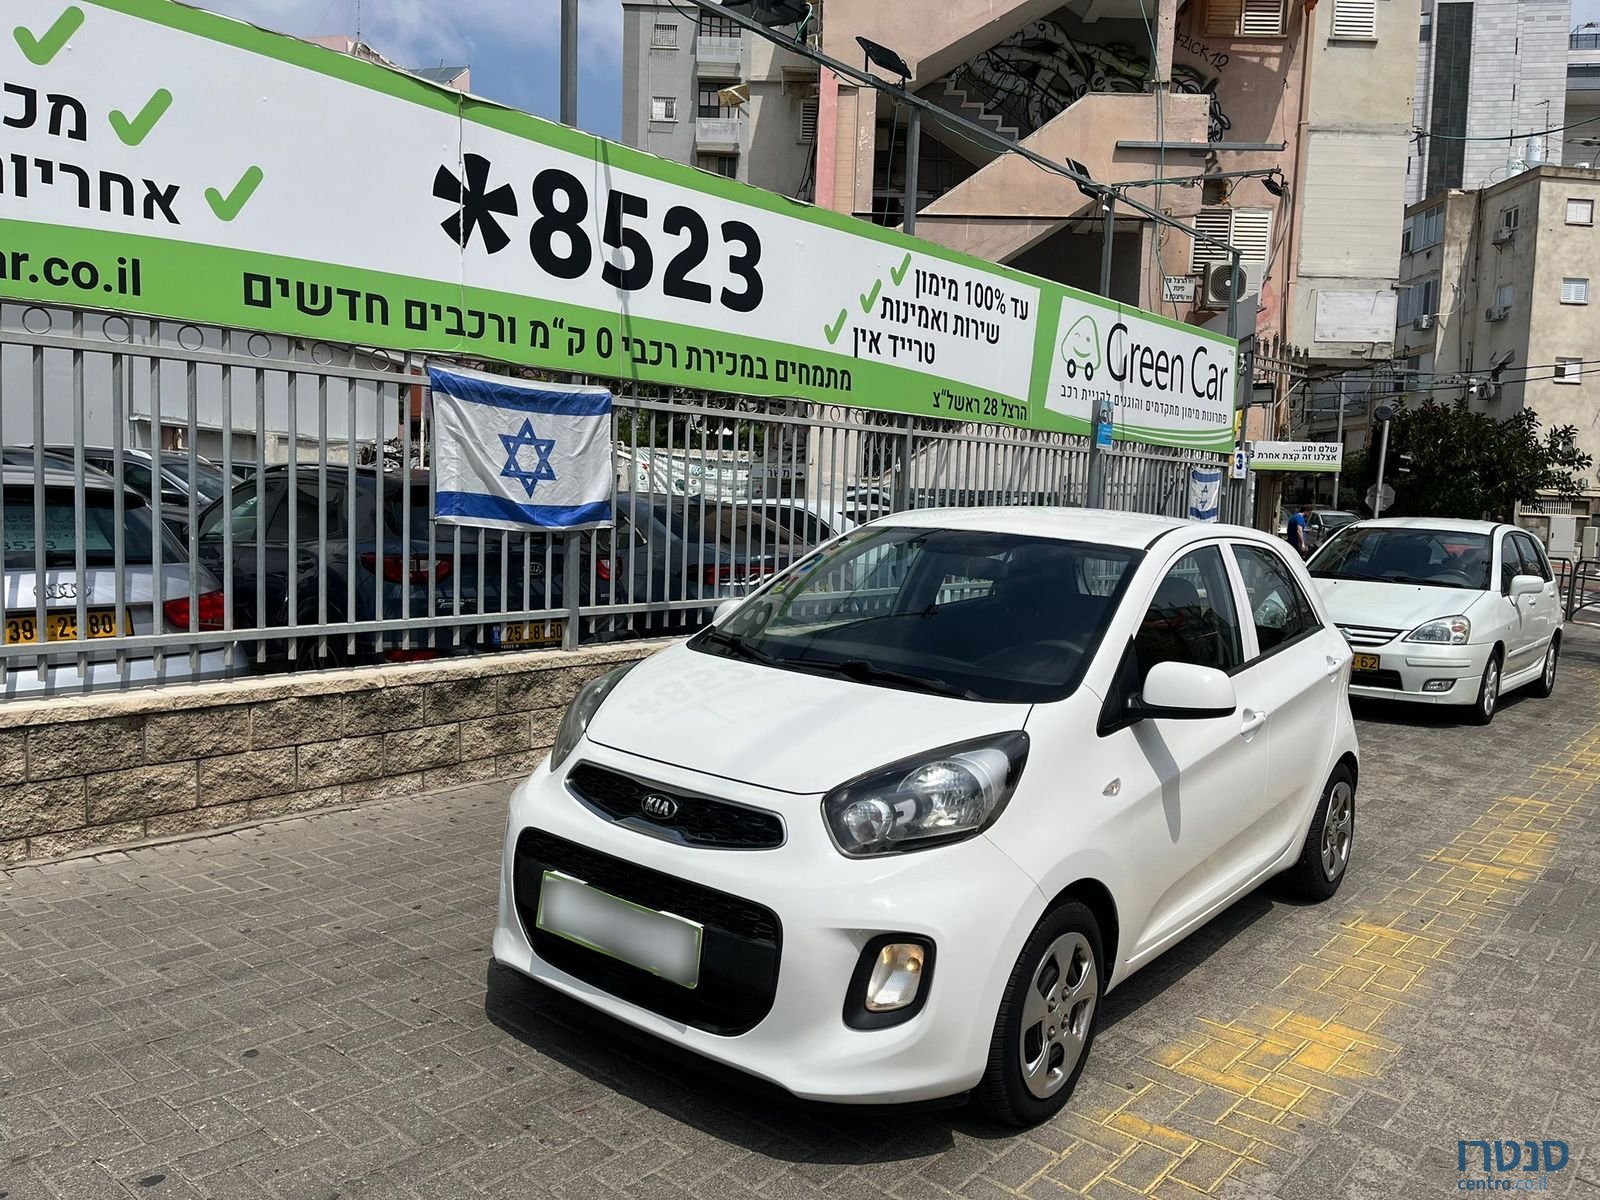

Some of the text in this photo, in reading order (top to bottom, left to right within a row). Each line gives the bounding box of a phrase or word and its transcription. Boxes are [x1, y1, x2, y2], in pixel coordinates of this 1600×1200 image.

[0, 152, 181, 225] אחריו
[915, 268, 1029, 321] עד 100% מימון
[880, 296, 1000, 345] שירות ואמינות
[243, 272, 852, 392] מתמחים במכירת רכבי 0 ק"מ ורכבים חדשים
[852, 326, 936, 365] טרייד אין
[1106, 322, 1228, 402] Green Car
[1061, 384, 1078, 401] רכב
[932, 389, 1027, 421] הרצל 28 ראשל"צ
[1114, 394, 1143, 411] והוגנים
[1145, 400, 1180, 418] מתקדמים
[1181, 406, 1200, 420] מימון
[1201, 410, 1227, 425] פתרונות
[1257, 452, 1281, 460] אחרת
[1281, 452, 1300, 462] קצת
[1313, 453, 1338, 461] אצלנו
[1318, 445, 1338, 453] שלם
[645, 796, 670, 816] KIA
